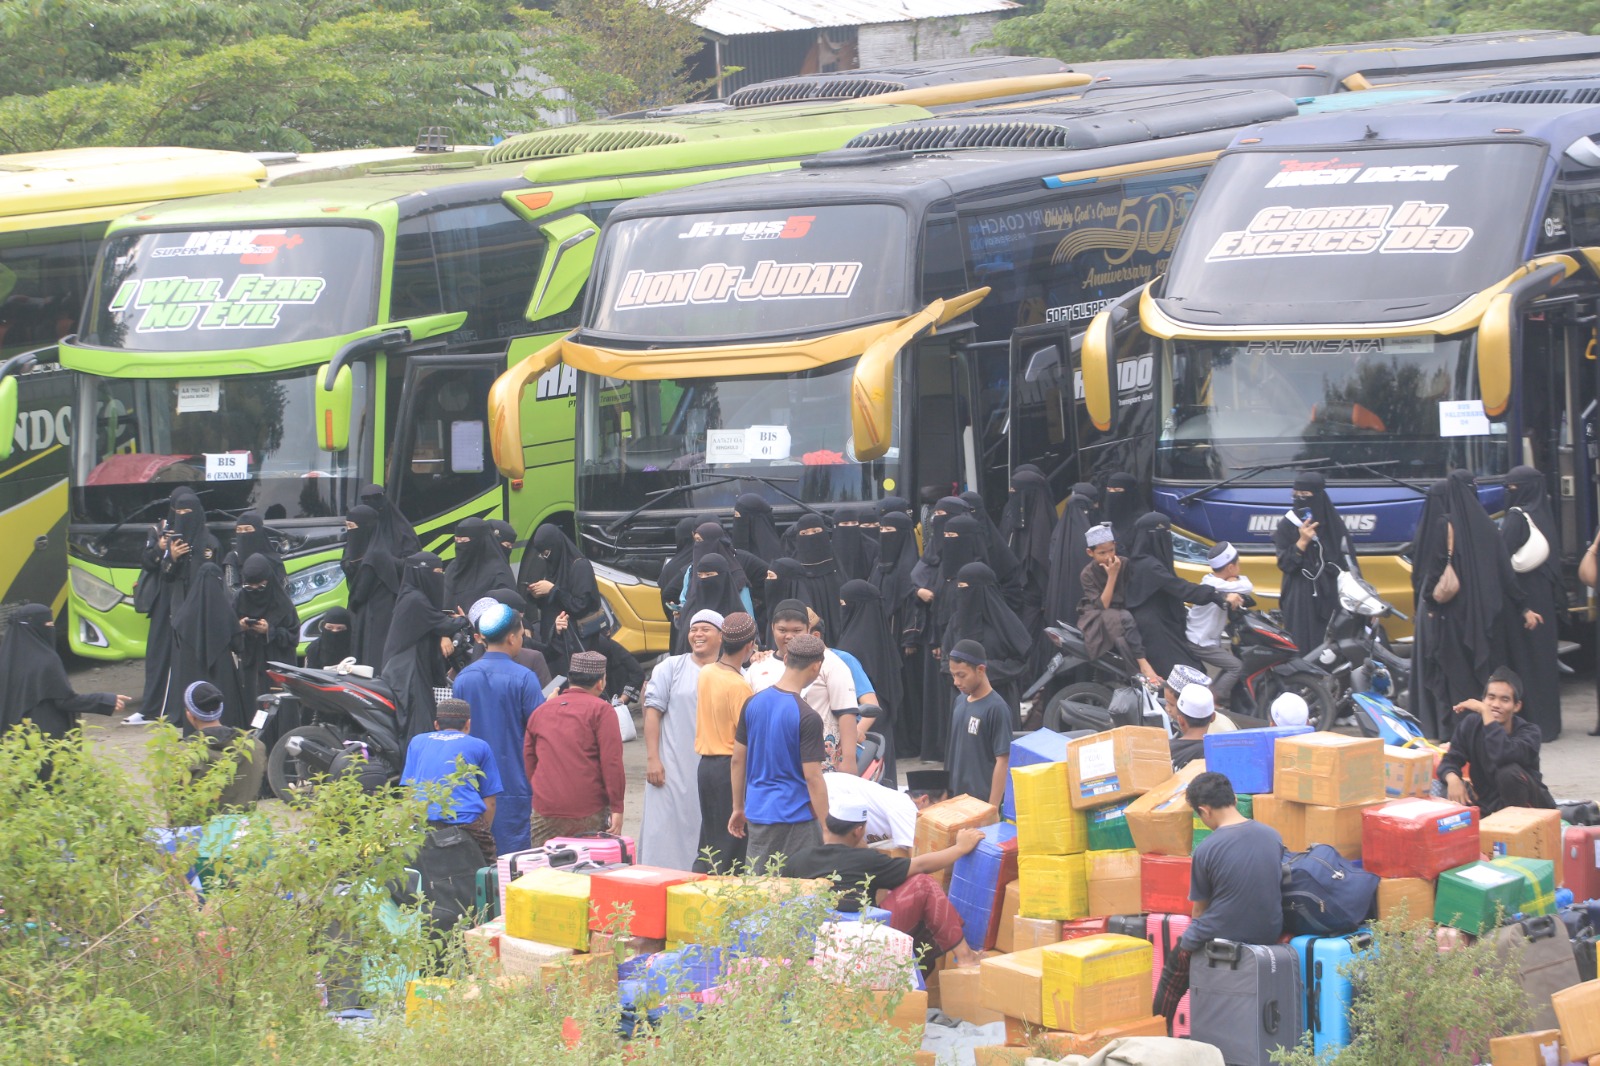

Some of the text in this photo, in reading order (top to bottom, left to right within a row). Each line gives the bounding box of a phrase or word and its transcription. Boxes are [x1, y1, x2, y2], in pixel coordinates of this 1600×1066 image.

[1248, 201, 1449, 234] GLORIA IN
[679, 220, 787, 239] JETBUS
[151, 247, 199, 257] SUPER
[1205, 226, 1474, 262] EXCELCIS DEO
[615, 260, 863, 310] LION OF JUDAH
[1082, 264, 1152, 289] Anniversary
[109, 274, 326, 311] I WILL FEAR
[136, 301, 280, 333] NO EVIL
[1247, 339, 1383, 355] PARIWISATA
[760, 432, 777, 441] BIS
[218, 457, 236, 466] BIS
[214, 471, 245, 480] (ENAM)
